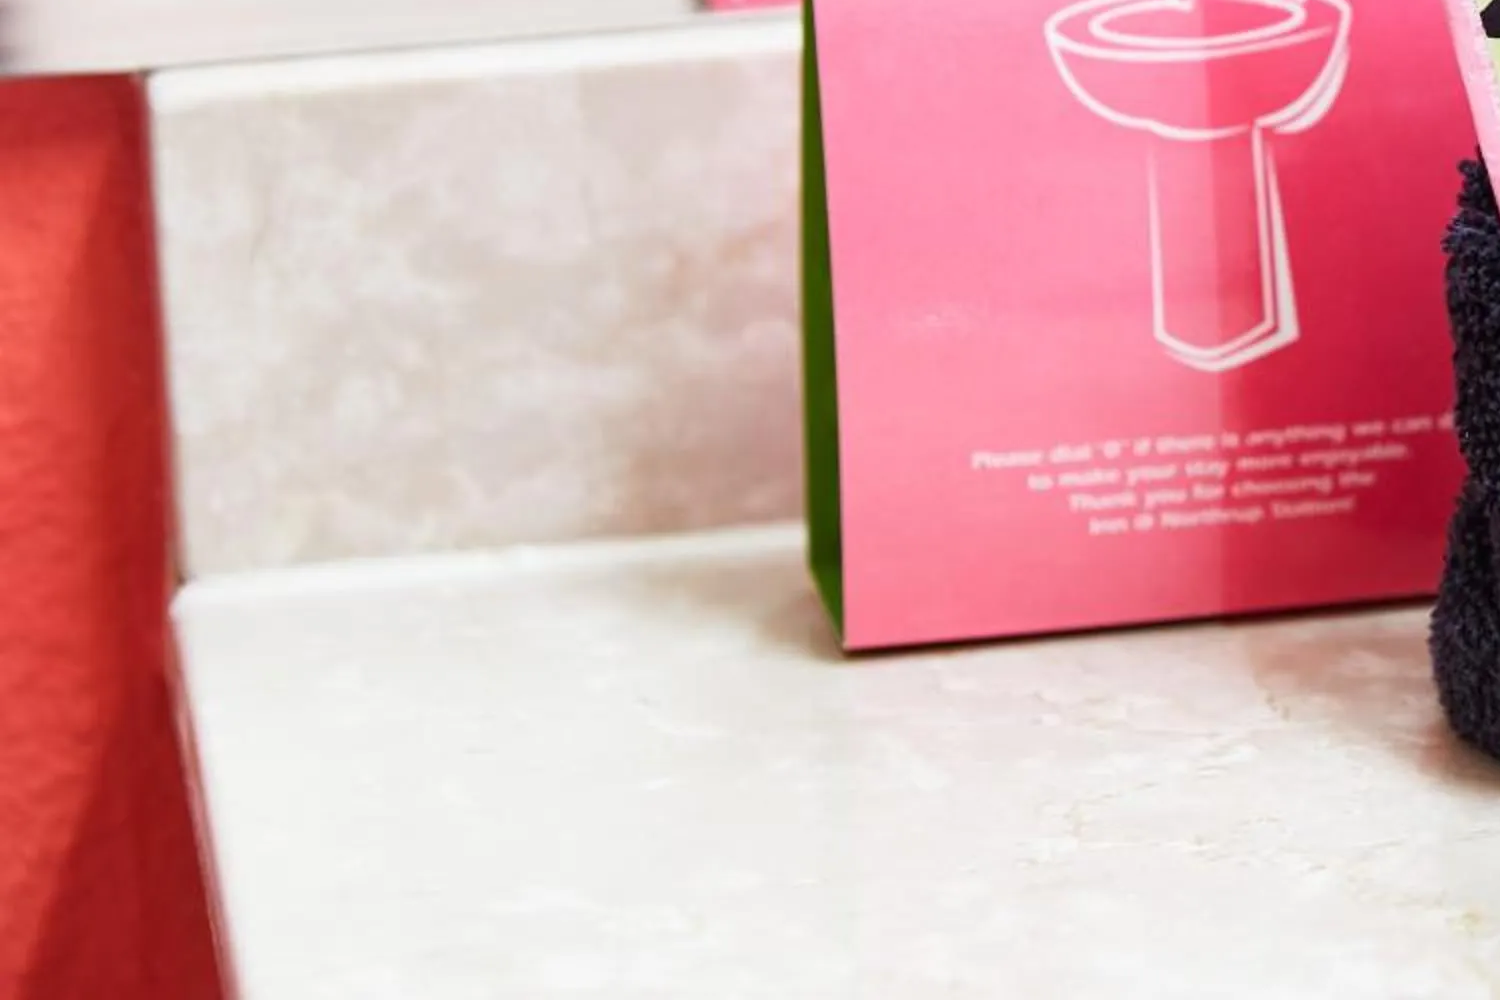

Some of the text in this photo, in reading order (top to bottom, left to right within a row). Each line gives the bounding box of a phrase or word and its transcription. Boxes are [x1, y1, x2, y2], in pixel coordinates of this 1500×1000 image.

[974, 449, 1043, 470] Please
[1155, 433, 1215, 454] there
[1246, 424, 1346, 448] anything
[1352, 420, 1384, 436] we
[1391, 416, 1433, 434] can
[1057, 467, 1121, 487] make
[1127, 463, 1178, 487] your
[1185, 460, 1229, 480] stay
[1236, 453, 1293, 472] more
[1070, 470, 1375, 512] Thank you for choosing the
